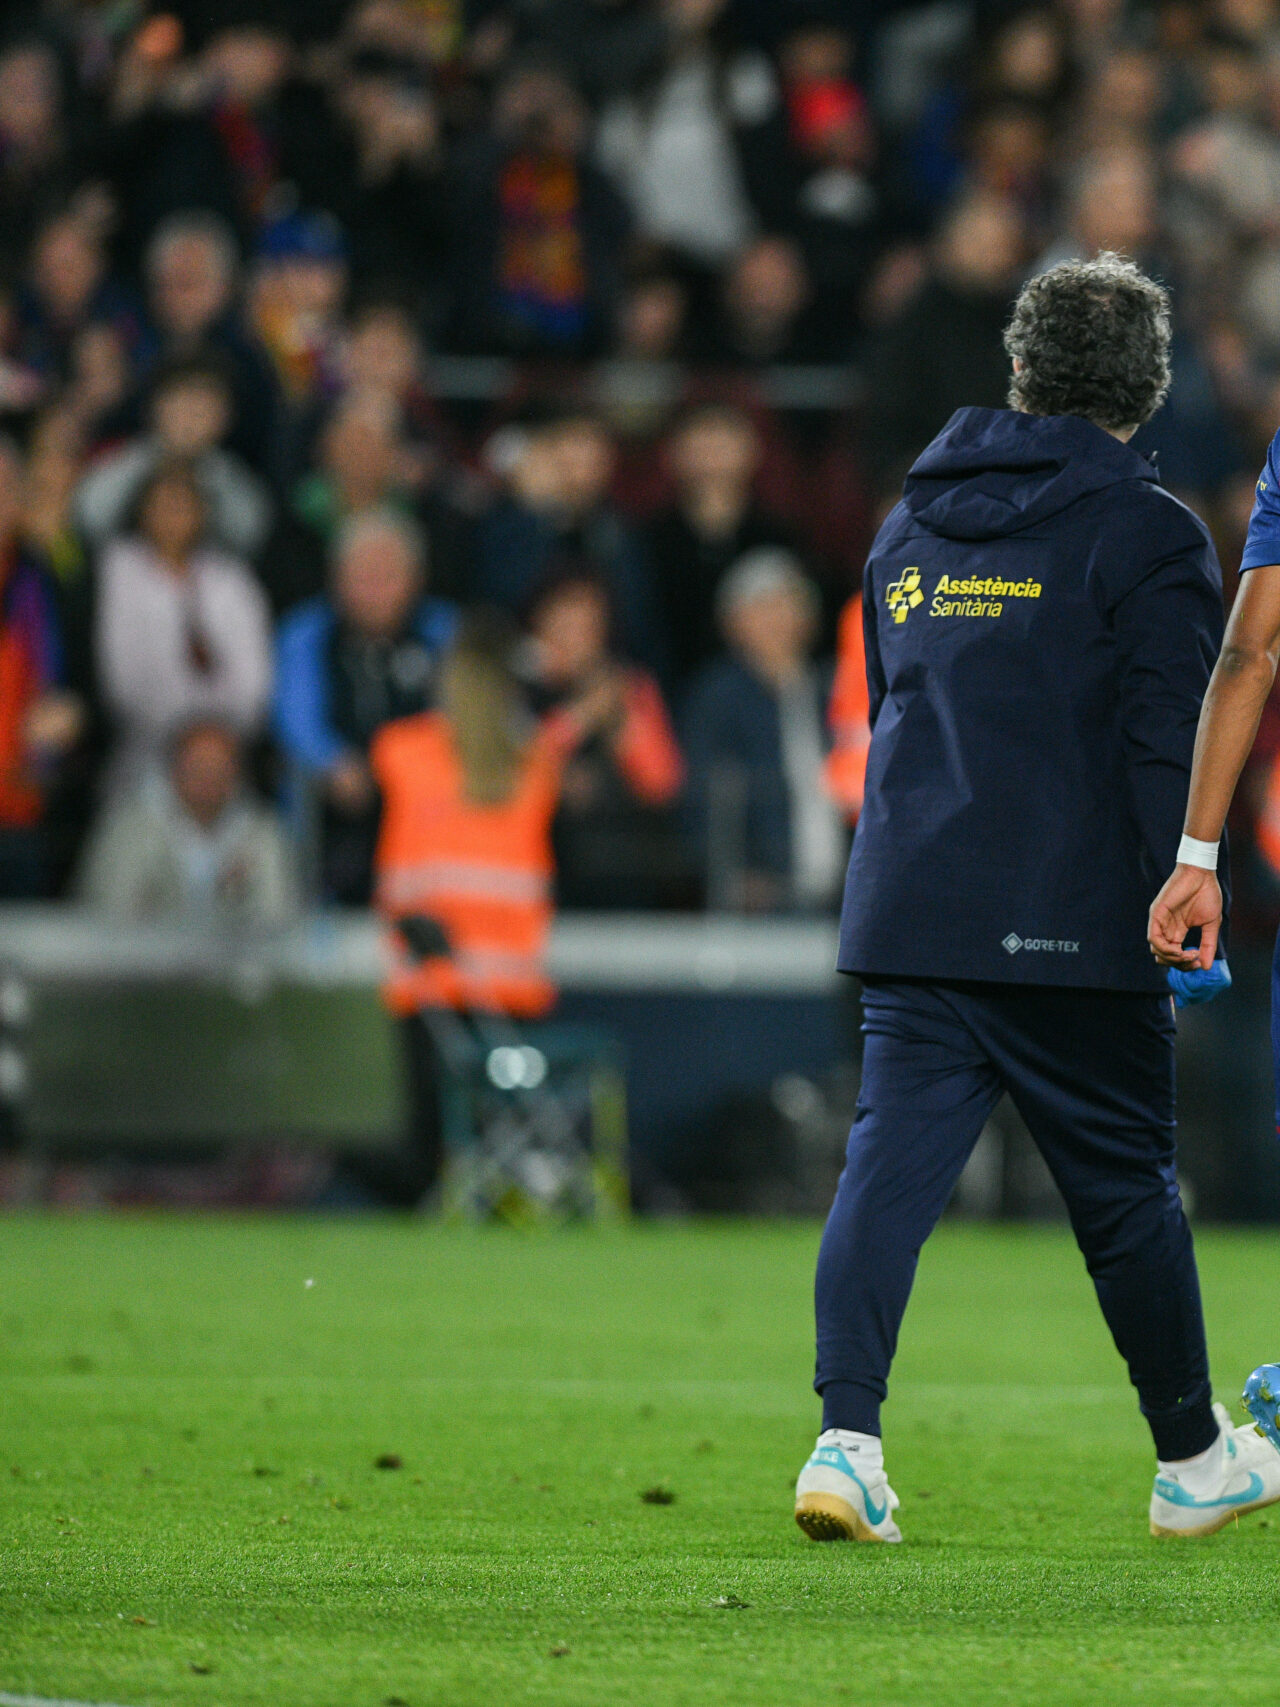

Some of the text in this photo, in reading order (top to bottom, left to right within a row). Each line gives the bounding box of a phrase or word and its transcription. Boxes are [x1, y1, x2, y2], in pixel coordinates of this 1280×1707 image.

[933, 574, 1043, 598] Assistència
[929, 596, 1004, 618] Sanitària
[1024, 938, 1080, 953] GORE-TEX
